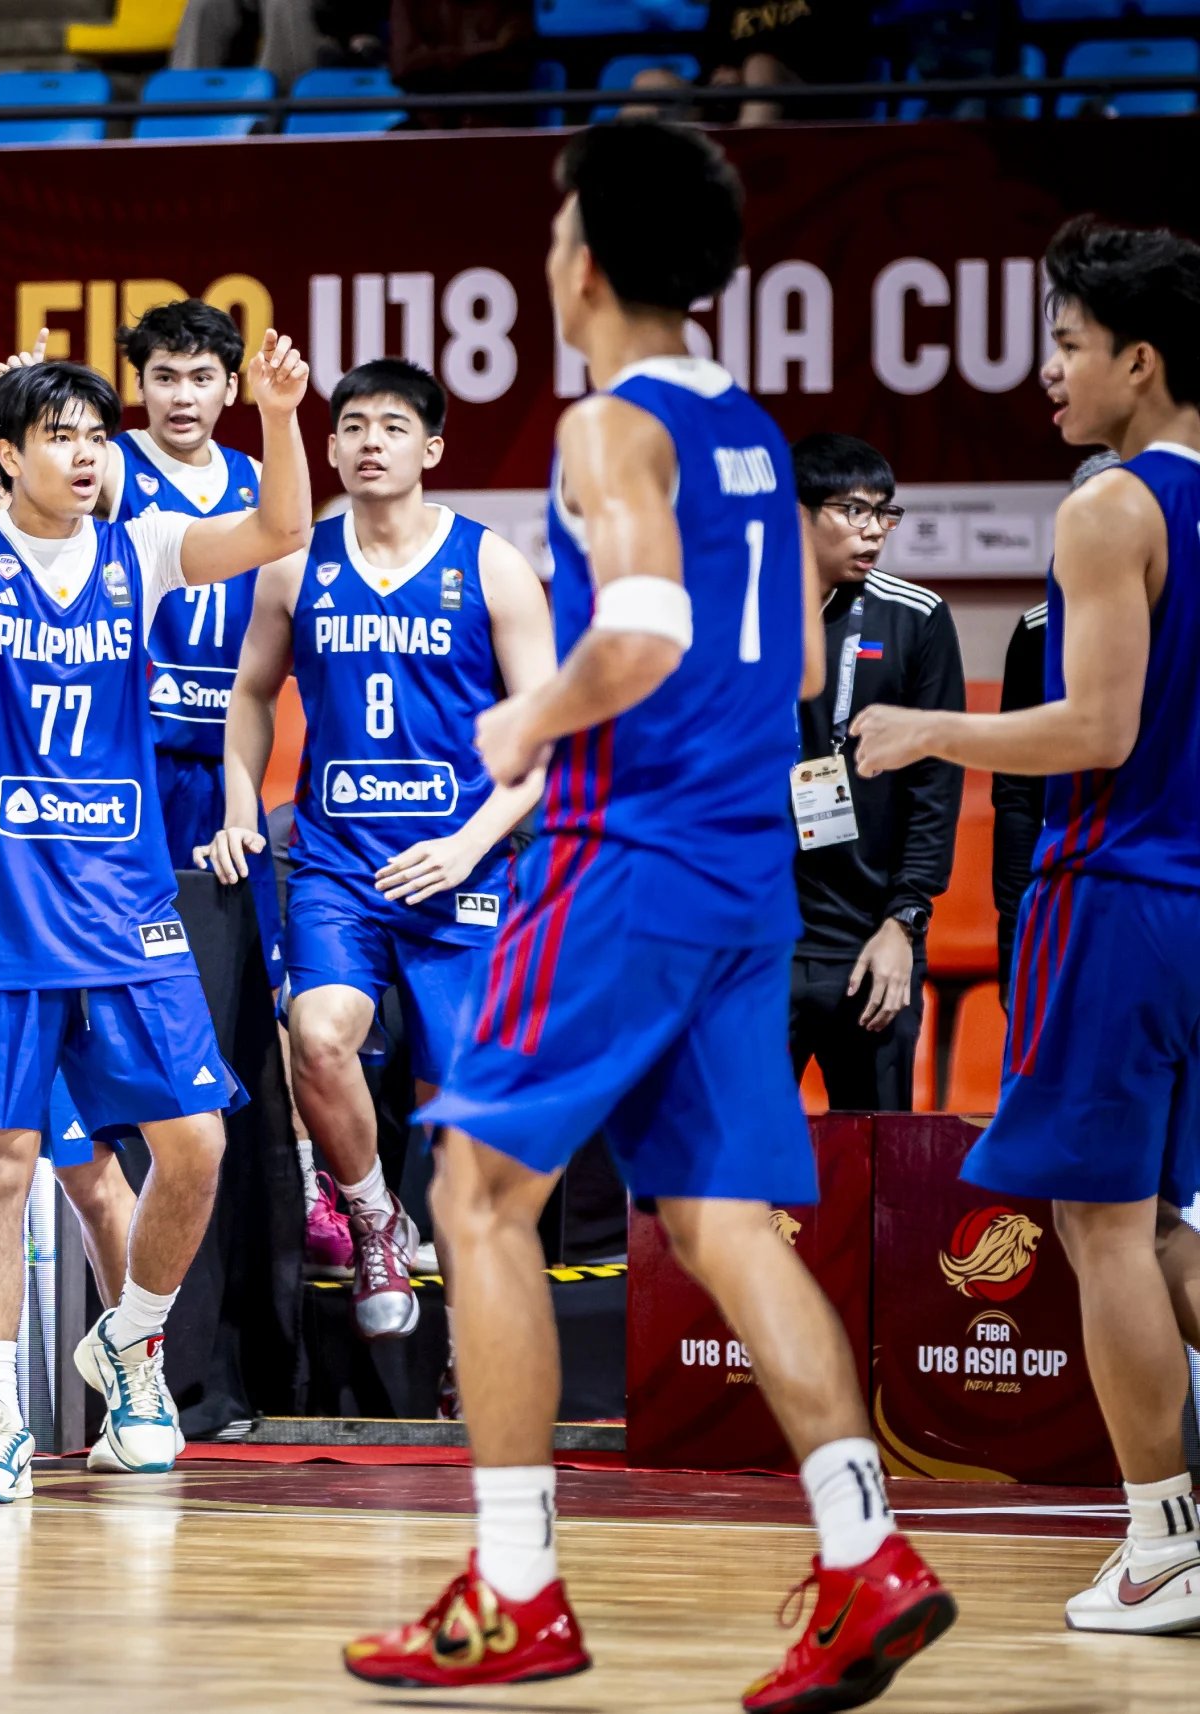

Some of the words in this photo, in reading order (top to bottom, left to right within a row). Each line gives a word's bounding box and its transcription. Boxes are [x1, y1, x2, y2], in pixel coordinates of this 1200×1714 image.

[308, 267, 518, 403] U18
[554, 258, 834, 399] IA
[871, 256, 1058, 395] CU
[738, 518, 765, 664] 1
[185, 583, 226, 648] 71
[315, 614, 452, 656] PILIPINAS
[182, 680, 232, 708] Sma
[365, 672, 395, 739] 8
[31, 684, 92, 757] 77
[358, 773, 447, 802] Smart
[40, 793, 126, 825] Smart
[976, 1323, 1010, 1342] FIBA
[681, 1339, 720, 1367] U18
[725, 1340, 753, 1368] AS
[918, 1345, 959, 1374] U18
[964, 1346, 1017, 1375] ASIA
[1023, 1348, 1068, 1377] CUP
[964, 1378, 994, 1392] INDIA
[995, 1382, 1022, 1394] 2026
[1184, 1578, 1193, 1595] 1
